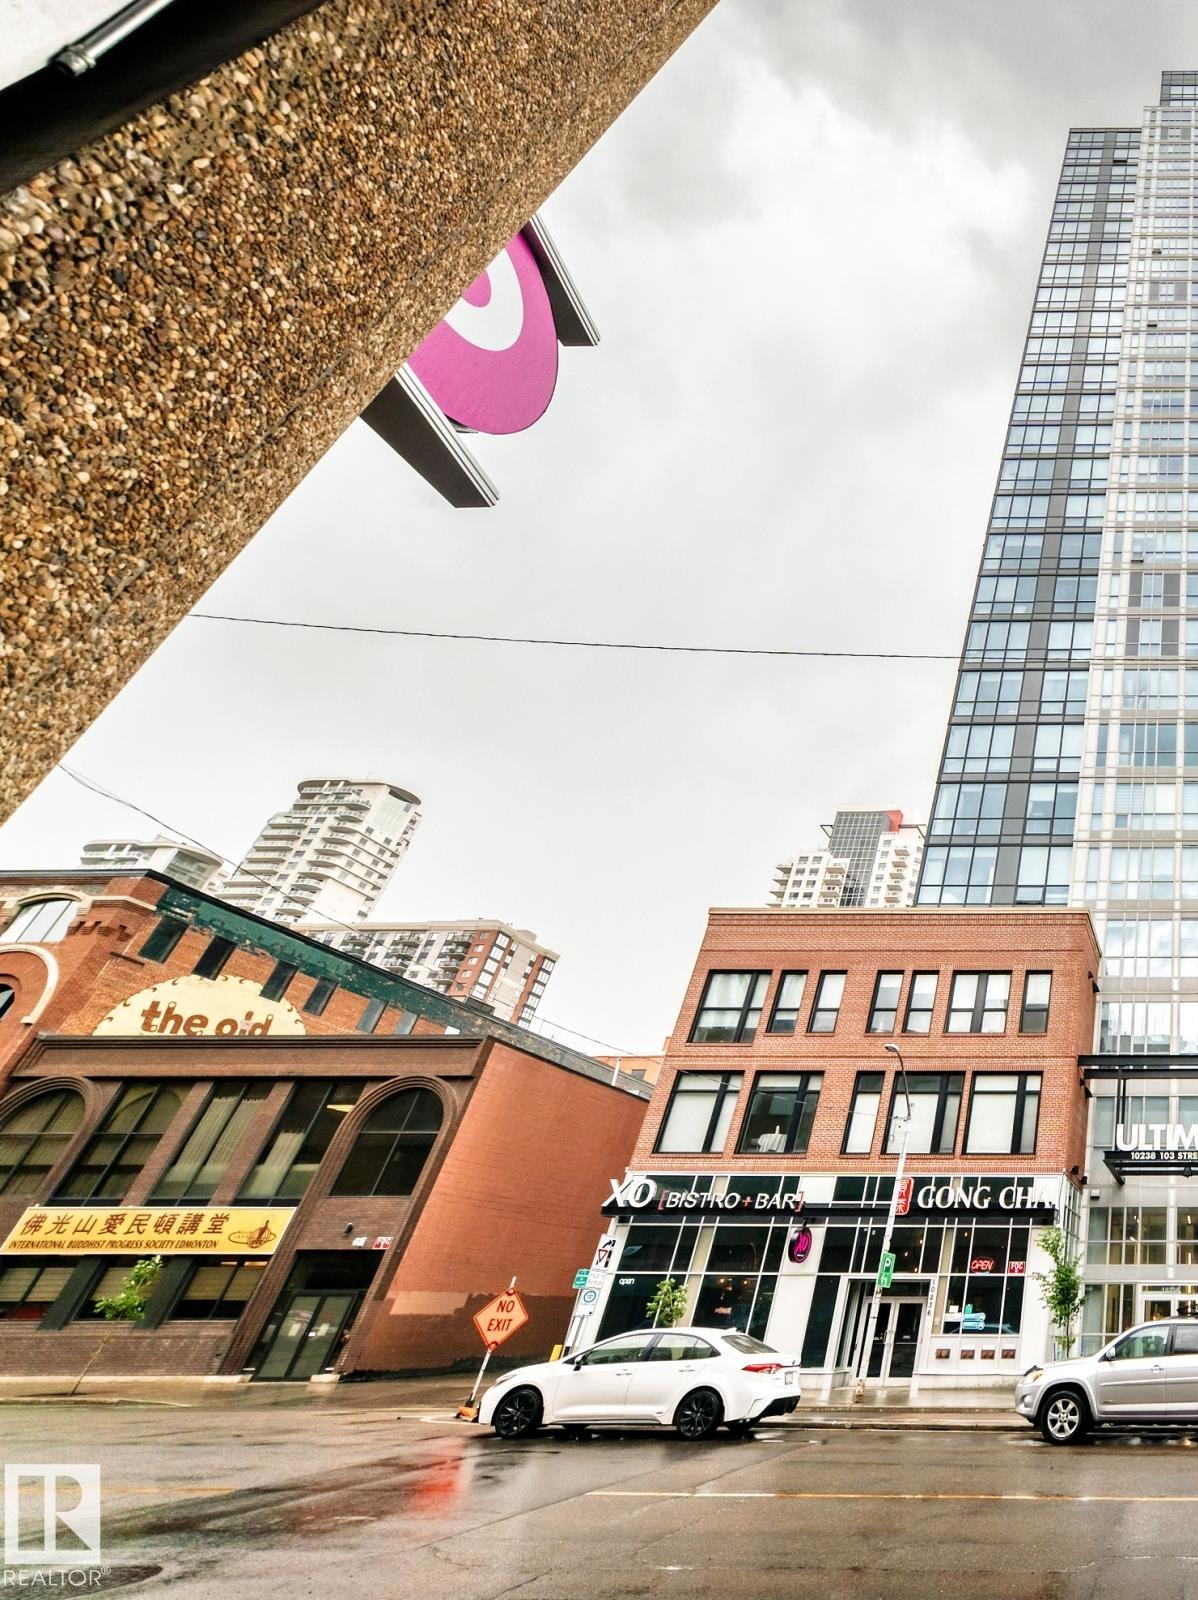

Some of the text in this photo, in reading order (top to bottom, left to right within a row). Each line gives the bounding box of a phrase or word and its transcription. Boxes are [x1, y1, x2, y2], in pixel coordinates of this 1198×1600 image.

[141, 1001, 209, 1035] the
[1130, 1151, 1156, 1160] 10238
[1159, 1151, 1175, 1160] 103
[602, 1178, 658, 1208] XO
[917, 1185, 1054, 1209] GONG CHA
[20, 1213, 231, 1236] 佛光山愛民頓講堂
[8, 1240, 64, 1249] INTERNATIONAL
[66, 1240, 106, 1249] BUDDHIST
[106, 1240, 143, 1249] PROGRESS
[144, 1240, 174, 1249] SOCIETY
[970, 1258, 994, 1271] OPEN
[496, 1300, 515, 1313] NO
[487, 1318, 513, 1331] EXIT
